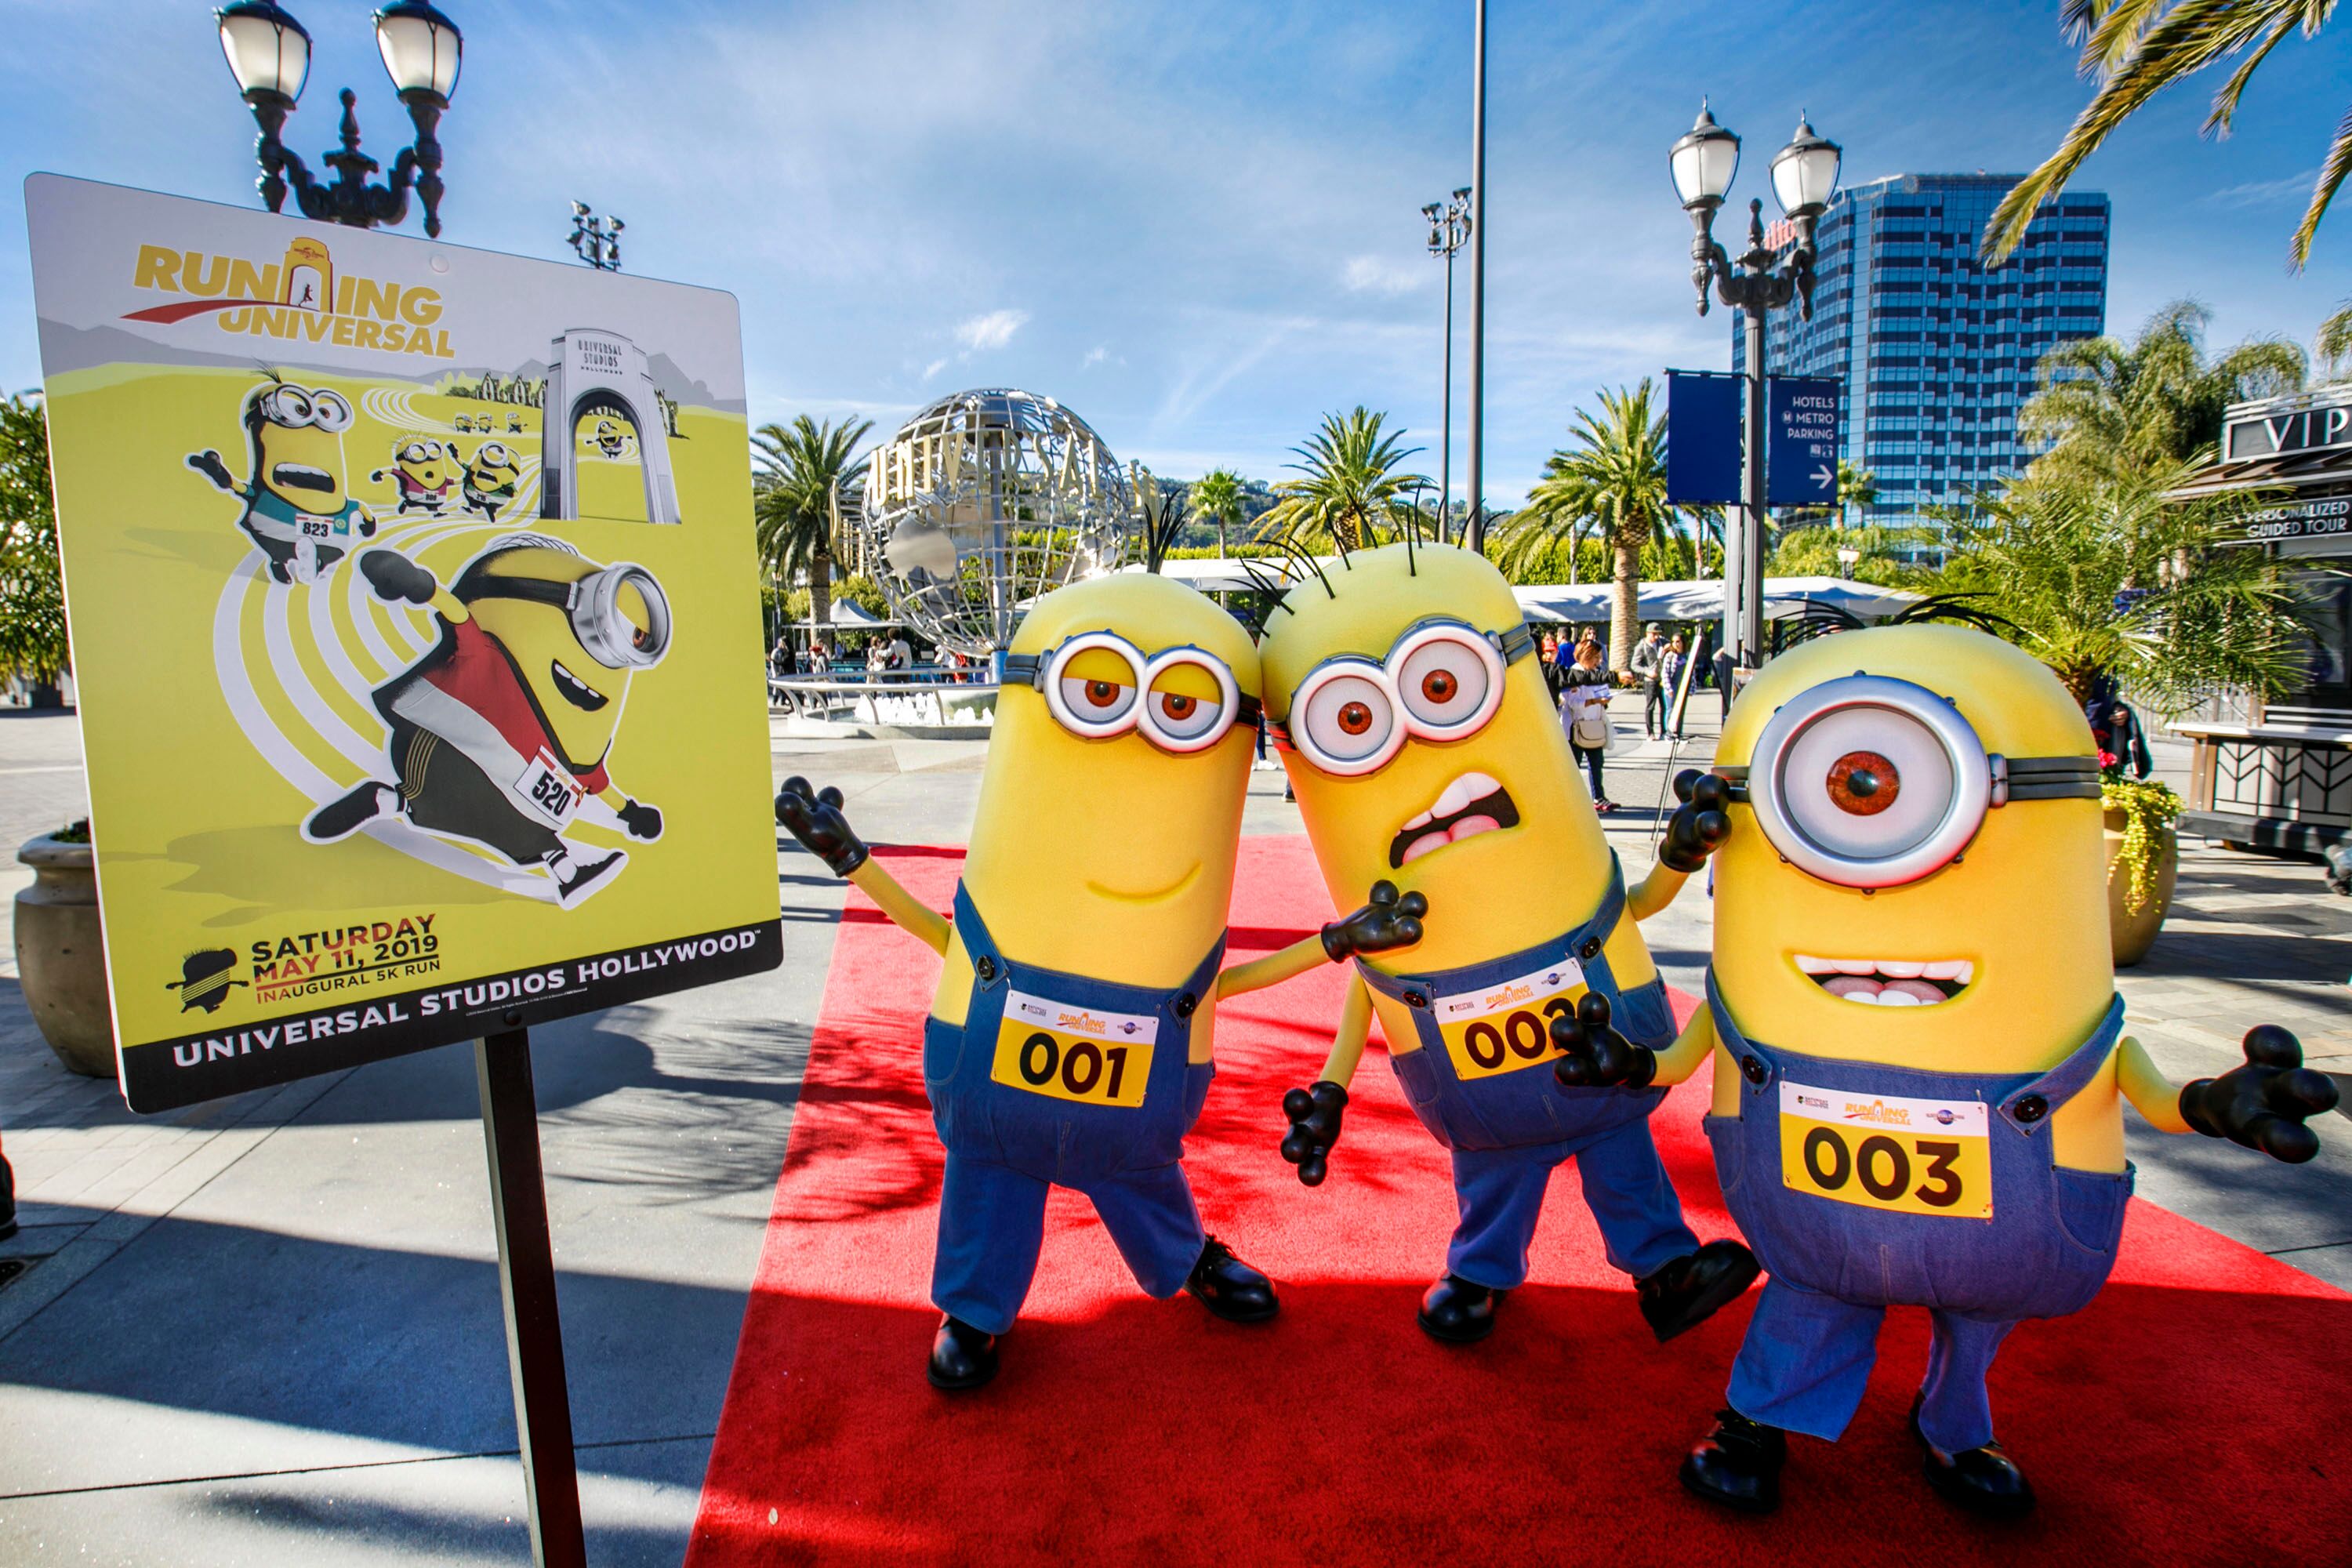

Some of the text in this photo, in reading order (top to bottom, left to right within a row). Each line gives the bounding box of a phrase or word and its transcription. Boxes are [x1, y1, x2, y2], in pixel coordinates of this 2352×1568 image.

[1764, 220, 1797, 252] ilto
[217, 307, 456, 359] UNIVERSAL
[578, 339, 622, 356] UNIVERSAL
[584, 353, 618, 367] STUDIOS
[1793, 396, 1835, 408] HOTELS
[1796, 412, 1835, 424] METRO
[1788, 427, 1834, 440] PARKING
[2263, 408, 2349, 452] VIP
[870, 430, 1098, 506] UNIVERSAL
[303, 522, 328, 537] 823
[2246, 518, 2347, 538] GUIDED TOUR
[532, 770, 572, 816] 520
[252, 913, 436, 962] SATURDAY
[252, 935, 439, 984] MAY 11, 2019
[256, 960, 441, 1004] INAUGURAL 5K RUN
[172, 1001, 409, 1067] UNIVERSAL
[420, 968, 565, 1016] STUDIOS
[1019, 1032, 1127, 1098] 001
[1803, 1126, 1962, 1207] 003
